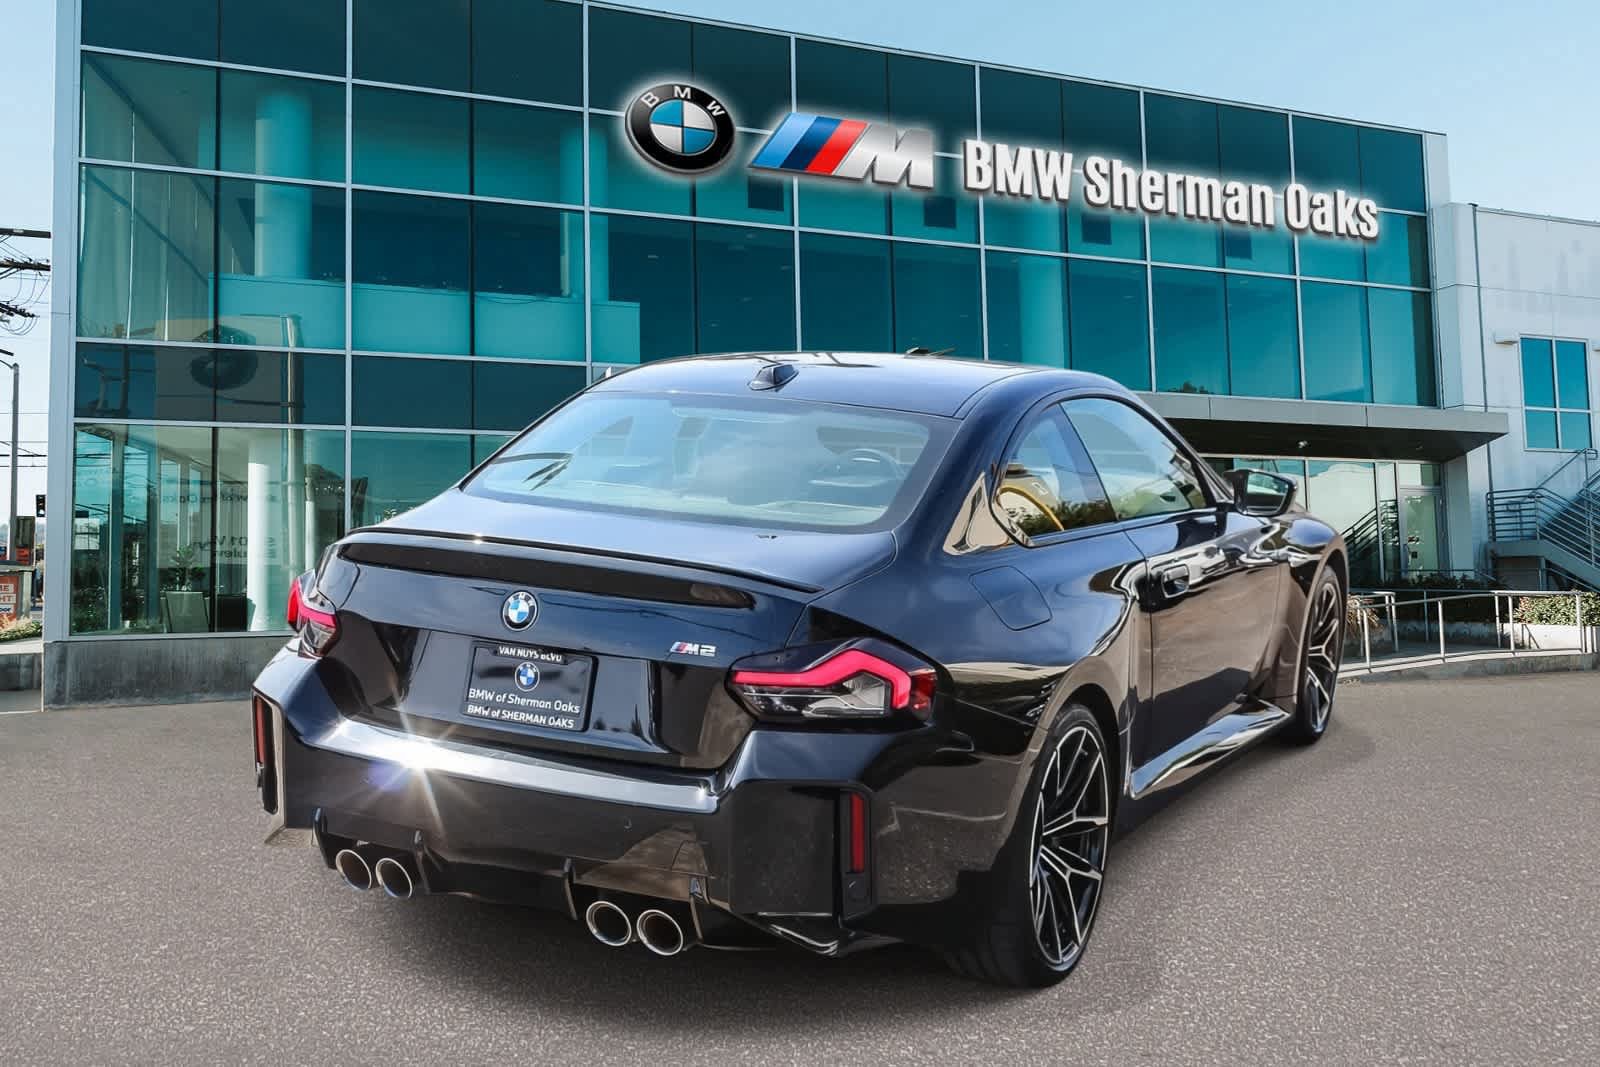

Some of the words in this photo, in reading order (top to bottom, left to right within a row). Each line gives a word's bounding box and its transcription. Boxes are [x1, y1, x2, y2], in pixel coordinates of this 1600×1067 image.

[641, 85, 726, 117] BMW
[964, 139, 1073, 201] BMW
[1084, 156, 1275, 228] Sherman
[1284, 184, 1379, 239] Oaks
[499, 646, 517, 656] VAN
[517, 648, 539, 659] NUYS
[468, 688, 496, 701] BMW
[496, 693, 507, 702] of
[507, 694, 552, 709] Sherman
[554, 700, 581, 714] Oaks
[467, 704, 490, 717] BMW
[491, 709, 500, 717] of
[501, 710, 547, 724] SHERMAN
[548, 718, 575, 728] OAKS
